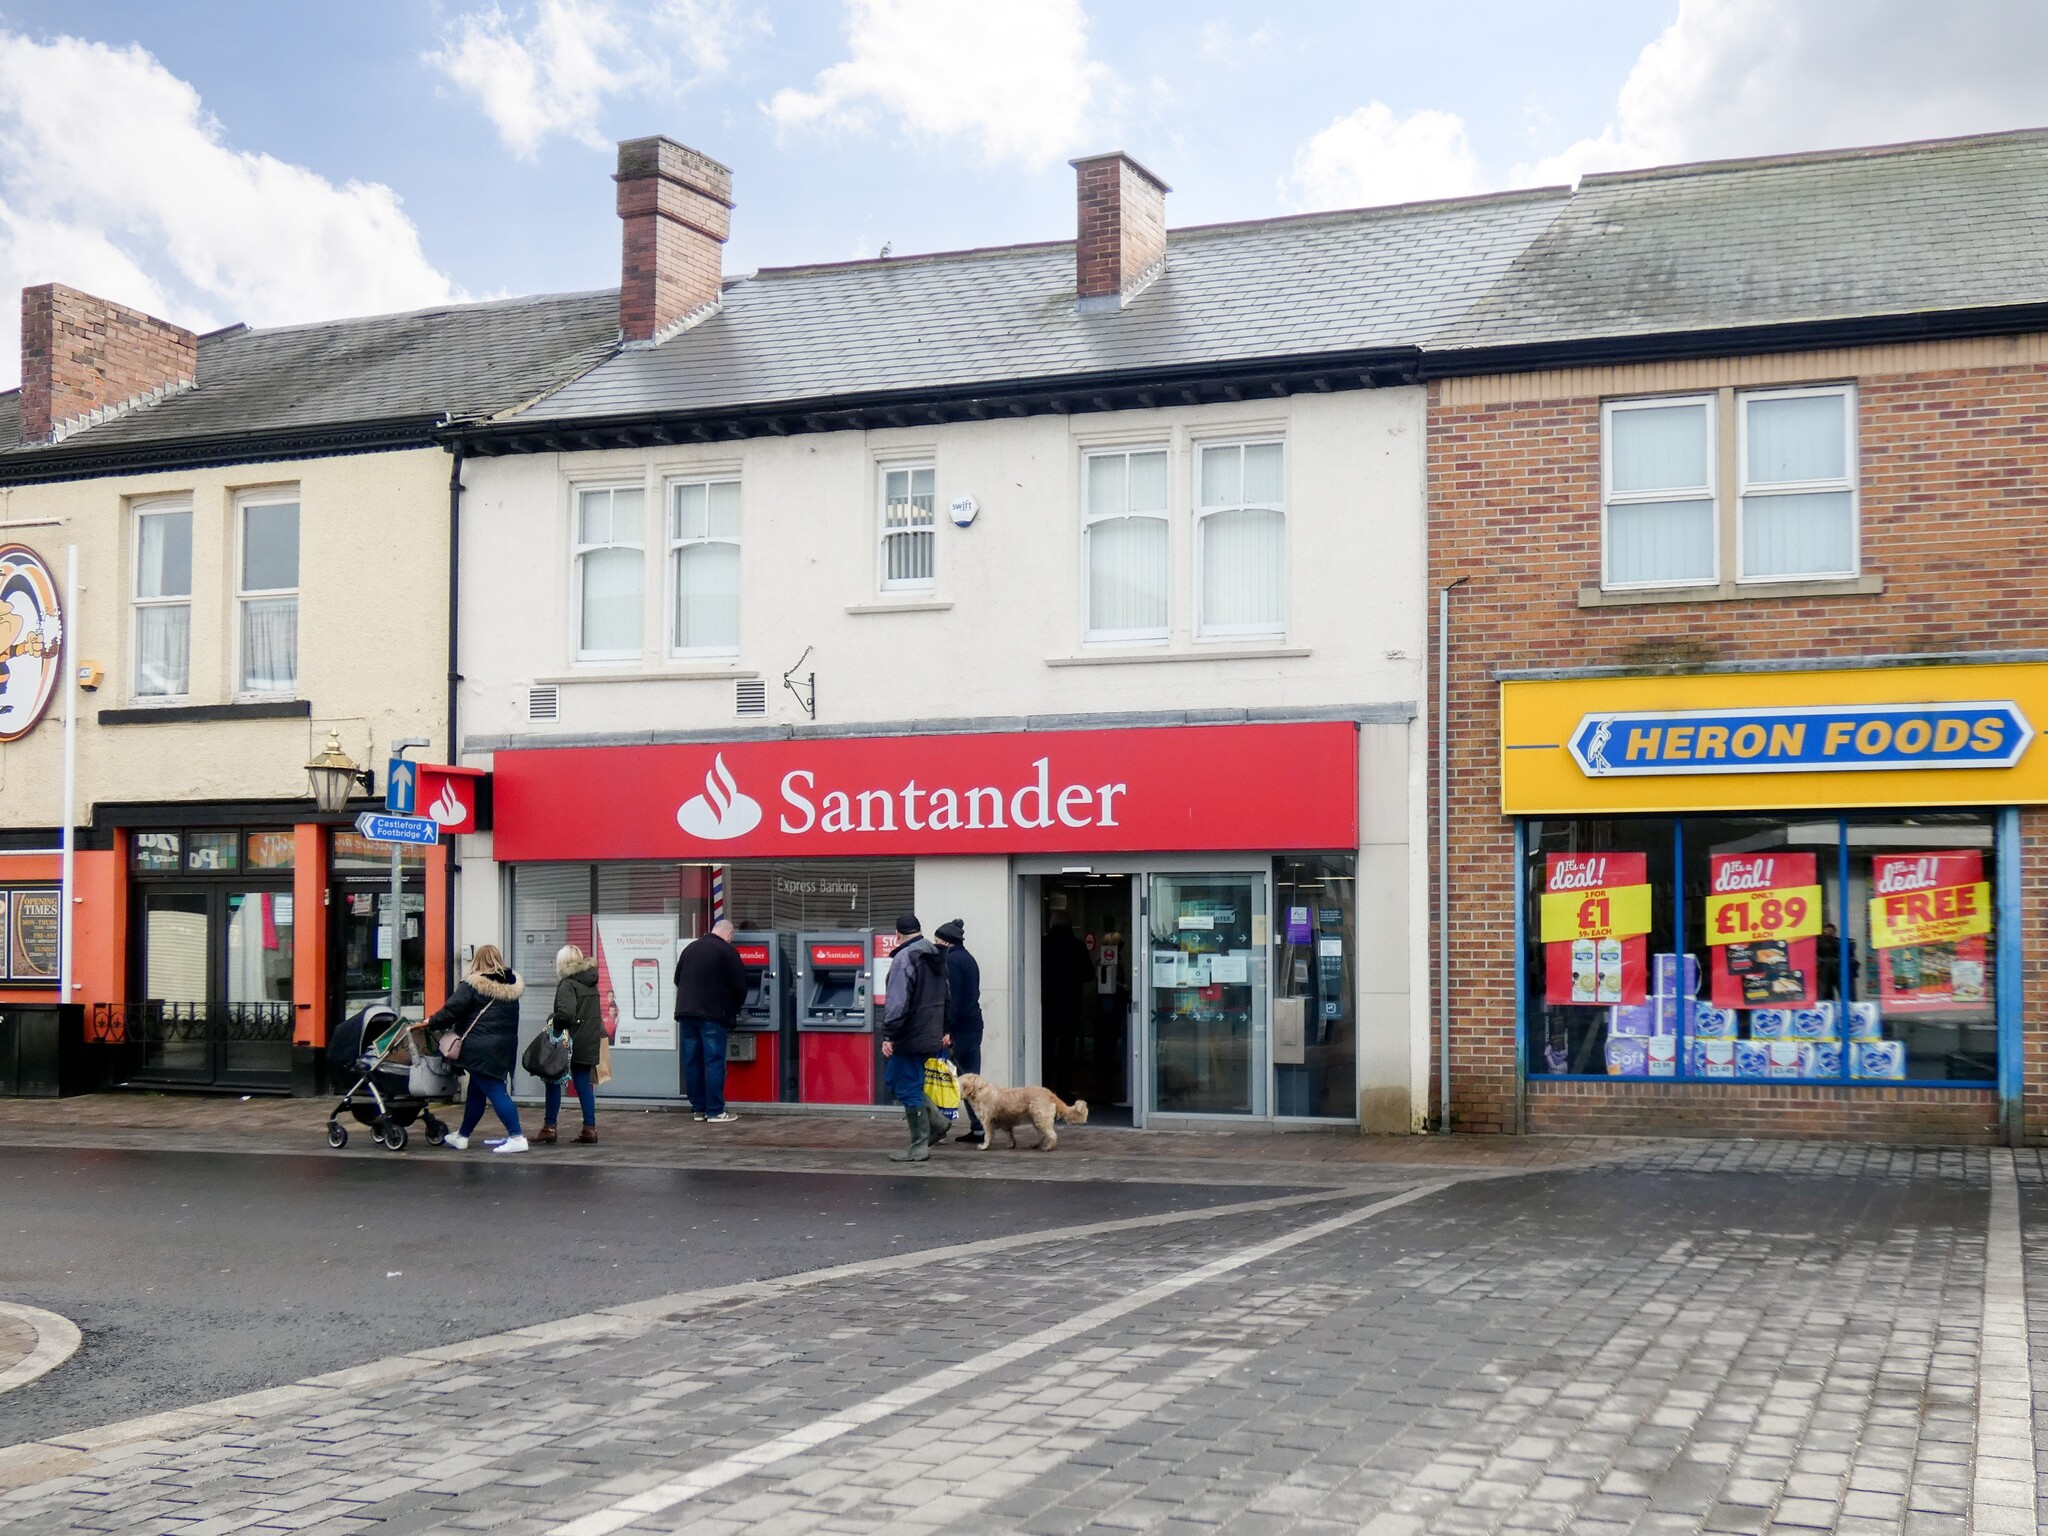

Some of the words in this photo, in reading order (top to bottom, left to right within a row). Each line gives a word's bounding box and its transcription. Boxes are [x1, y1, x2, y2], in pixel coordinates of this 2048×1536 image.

[1624, 723, 1807, 761] HERON
[1822, 717, 2005, 755] FOODS
[780, 757, 1127, 834] Santander
[377, 819, 422, 830] Castleford
[377, 828, 421, 839] Footbridge
[1564, 860, 1578, 872] It's
[1730, 861, 1745, 873] It's
[1550, 858, 1606, 890] deal!
[1715, 858, 1774, 891] deal!
[1878, 858, 1938, 893] deal!
[777, 877, 816, 895] Express
[820, 877, 858, 897] Banking
[1584, 891, 1590, 899] 2
[1590, 890, 1607, 898] FOR
[1751, 892, 1775, 900] ONLY
[24, 905, 57, 915] TIMES
[1886, 885, 1978, 927] FREE
[1577, 897, 1610, 929] £1
[1715, 897, 1807, 934] £1.89
[1591, 928, 1612, 937] EACH
[1752, 931, 1774, 939] EACH
[882, 937, 900, 947] STO
[740, 951, 765, 959] ntander
[826, 951, 860, 959] Santander
[1610, 1051, 1646, 1065] Soft
